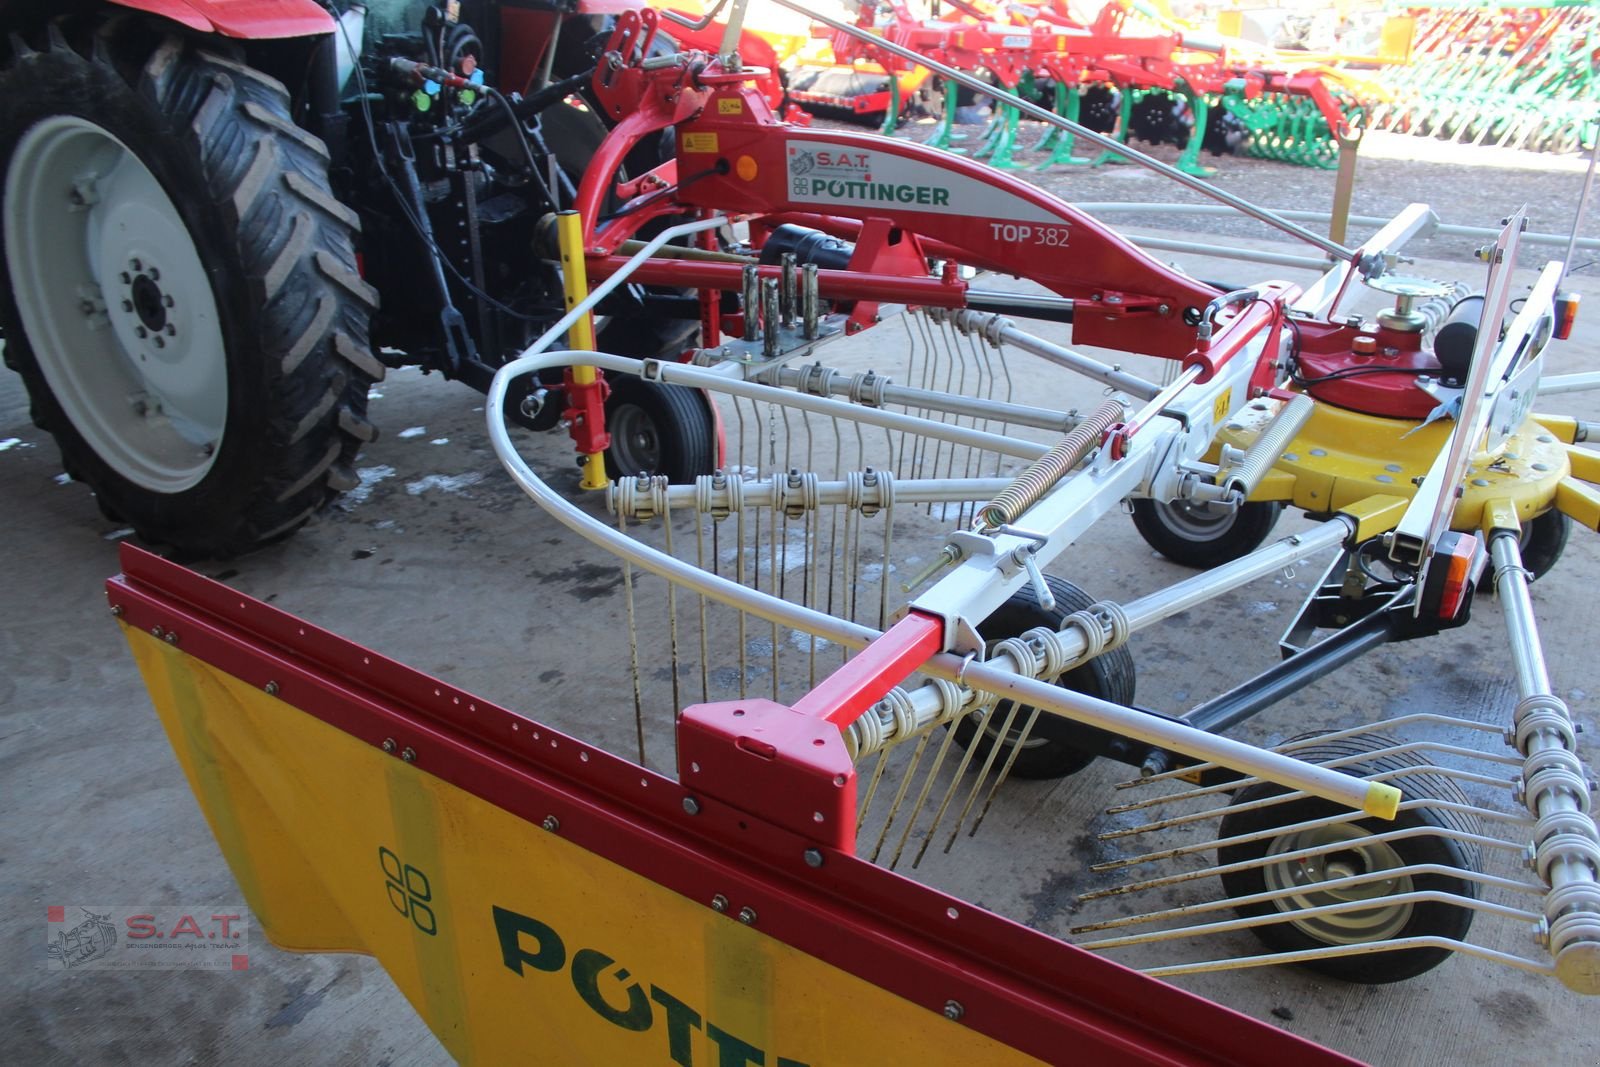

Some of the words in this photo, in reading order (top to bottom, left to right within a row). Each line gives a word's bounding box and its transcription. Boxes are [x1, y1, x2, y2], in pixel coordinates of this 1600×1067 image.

[812, 179, 950, 207] PÖTTINGER
[990, 223, 1031, 243] TOP
[1034, 226, 1070, 248] 382
[492, 905, 811, 1067] PÖTT
